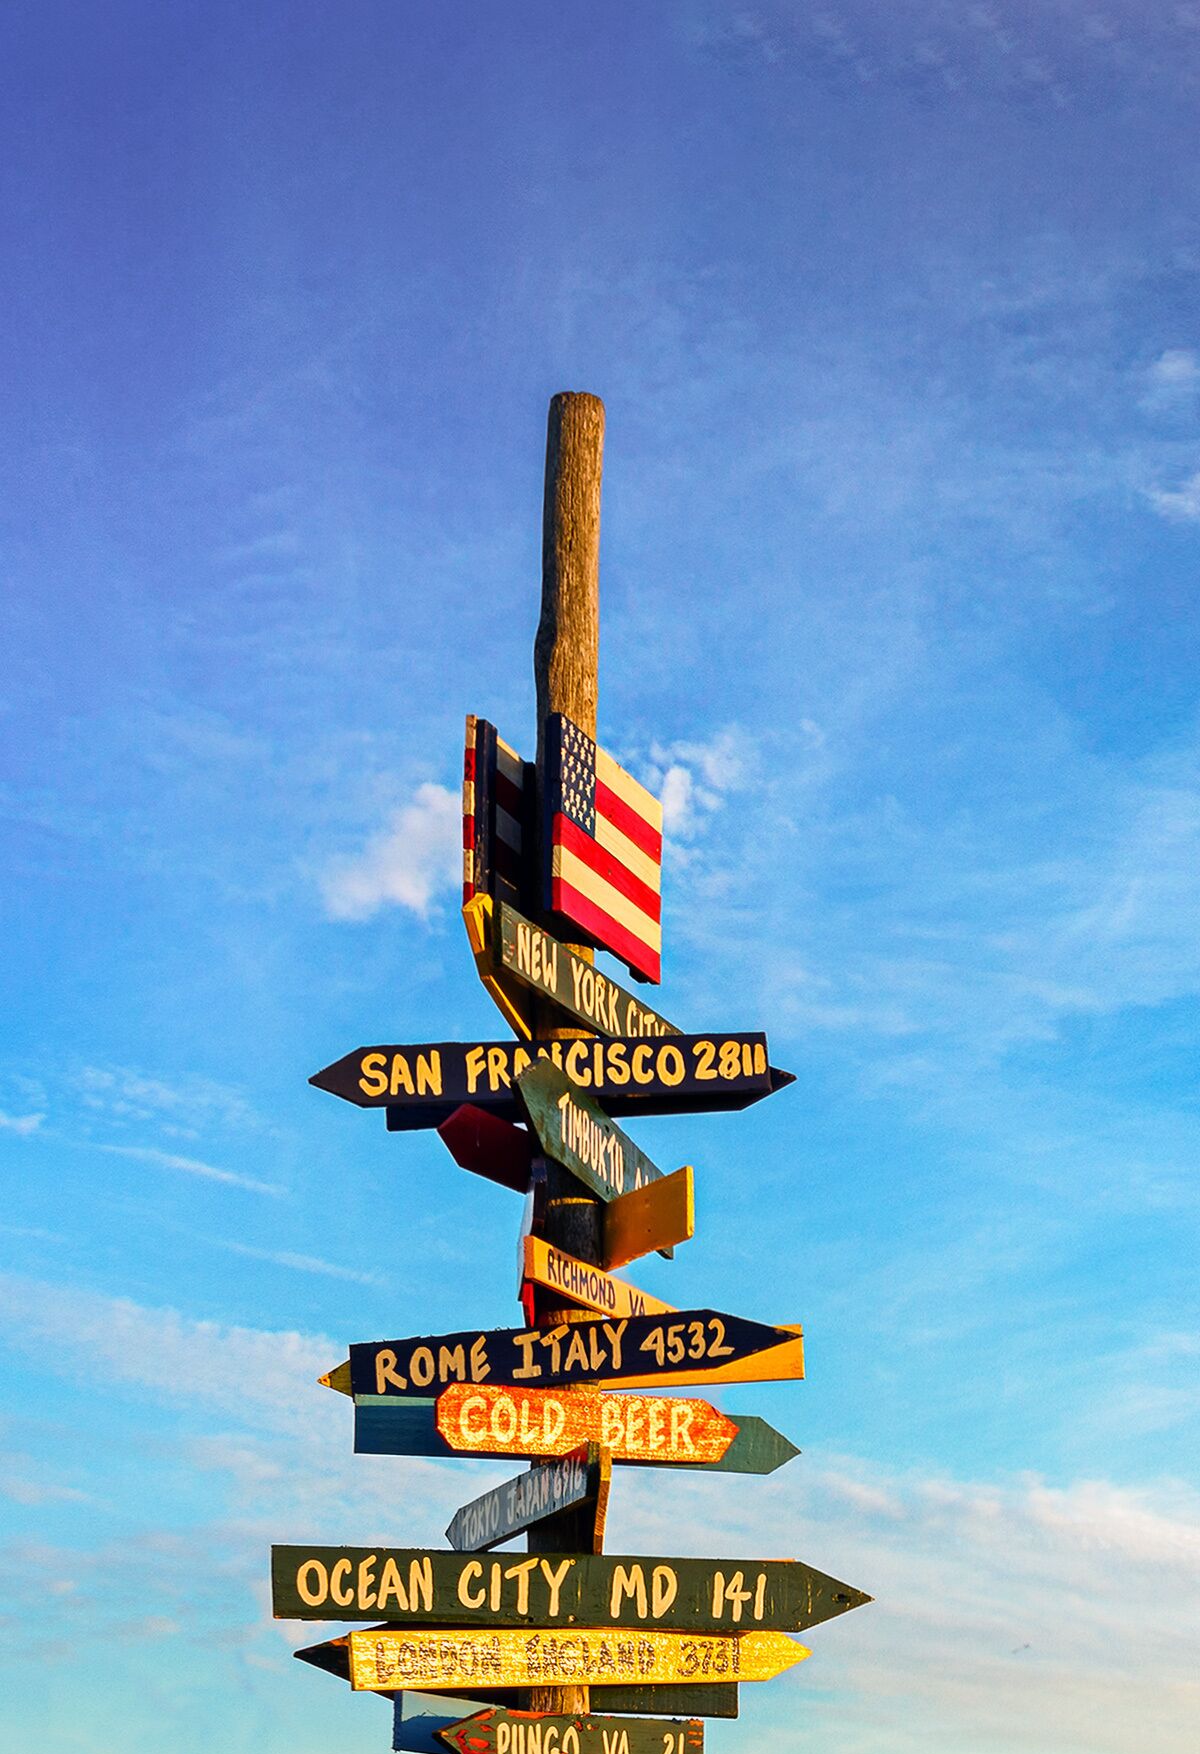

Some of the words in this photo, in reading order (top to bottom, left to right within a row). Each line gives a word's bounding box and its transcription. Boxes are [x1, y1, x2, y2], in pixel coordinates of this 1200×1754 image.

[517, 922, 557, 993] NEW
[571, 957, 621, 1036] YORK
[358, 1049, 442, 1097] SAN
[692, 1040, 767, 1080] 2811
[558, 1092, 624, 1195] TIMBUKTU
[547, 1249, 616, 1309] RICHMOND
[375, 1335, 490, 1394] ROME
[512, 1319, 629, 1380] ITALY
[640, 1318, 735, 1366] 4532
[458, 1393, 566, 1444] COLD
[601, 1401, 698, 1453] BEER
[462, 1493, 500, 1547] TOKYO
[507, 1467, 549, 1525] JAPAN
[296, 1556, 433, 1613] OCEAN
[458, 1557, 575, 1617] CITY
[611, 1564, 677, 1619] MD
[712, 1571, 767, 1623] 141
[375, 1636, 500, 1683] LONDON
[525, 1634, 656, 1679] ENGLAND
